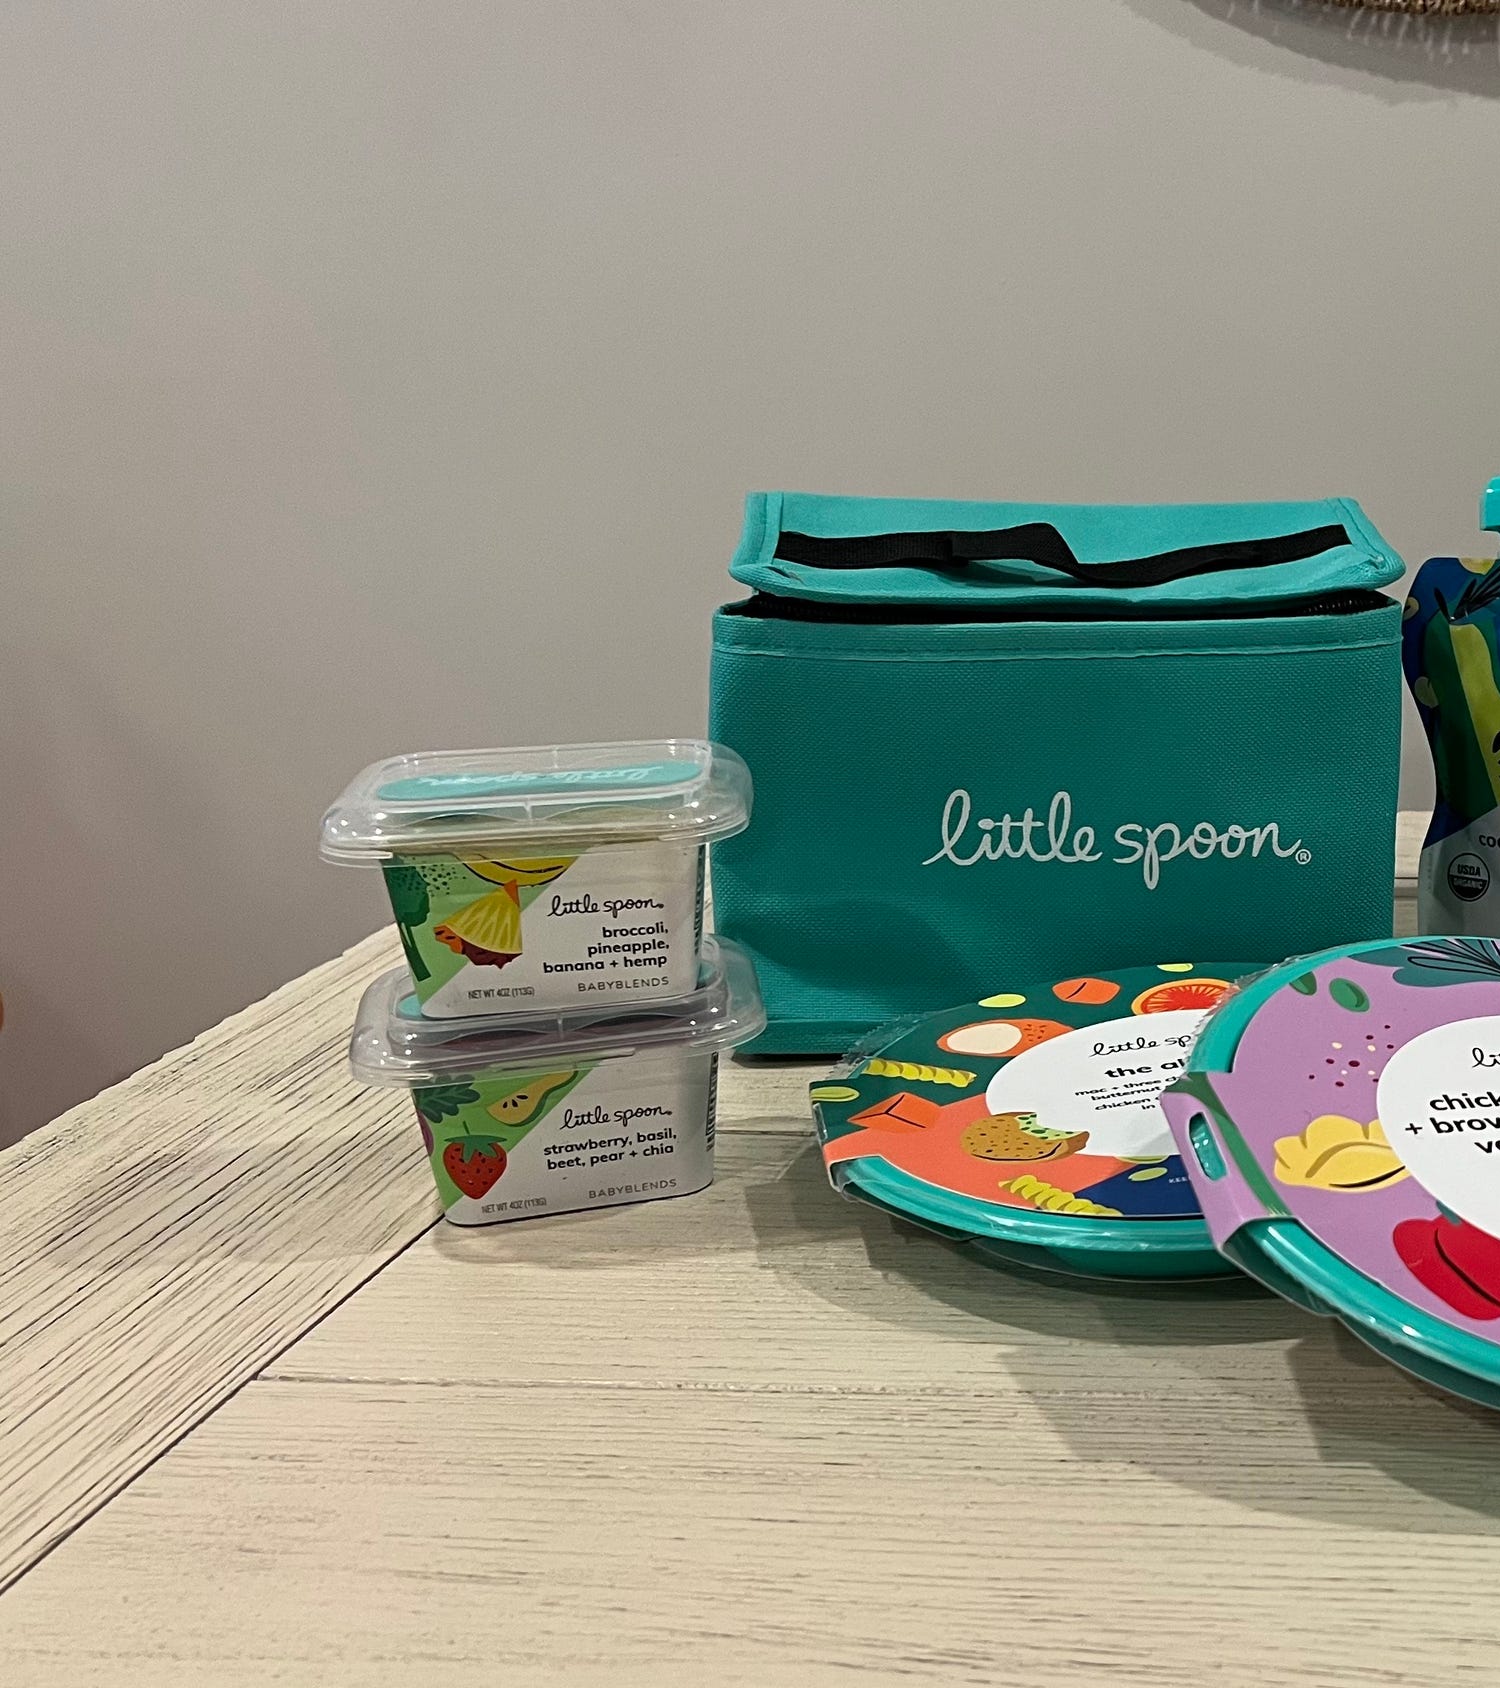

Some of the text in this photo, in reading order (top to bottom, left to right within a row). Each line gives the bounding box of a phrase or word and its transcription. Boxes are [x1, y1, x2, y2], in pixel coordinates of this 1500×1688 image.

[922, 788, 1103, 866] little
[1457, 864, 1481, 877] USDA
[547, 893, 600, 917] little
[602, 921, 669, 938] broccoli,
[587, 938, 670, 957] pineapple,
[543, 955, 668, 973] banana + hemp
[578, 976, 670, 992] BABYBLENDS
[1088, 1037, 1161, 1058] little
[1104, 1065, 1153, 1078] the
[1074, 1085, 1108, 1097] mac
[1123, 1079, 1162, 1090] three
[1090, 1085, 1161, 1102] butternut
[1095, 1097, 1152, 1111] chicken
[559, 1105, 611, 1130] little
[1405, 1122, 1423, 1135] +
[543, 1127, 678, 1156] strawberry, basil,
[547, 1143, 675, 1170] beet, pear + chia
[588, 1178, 678, 1199] BABYBLENDS
